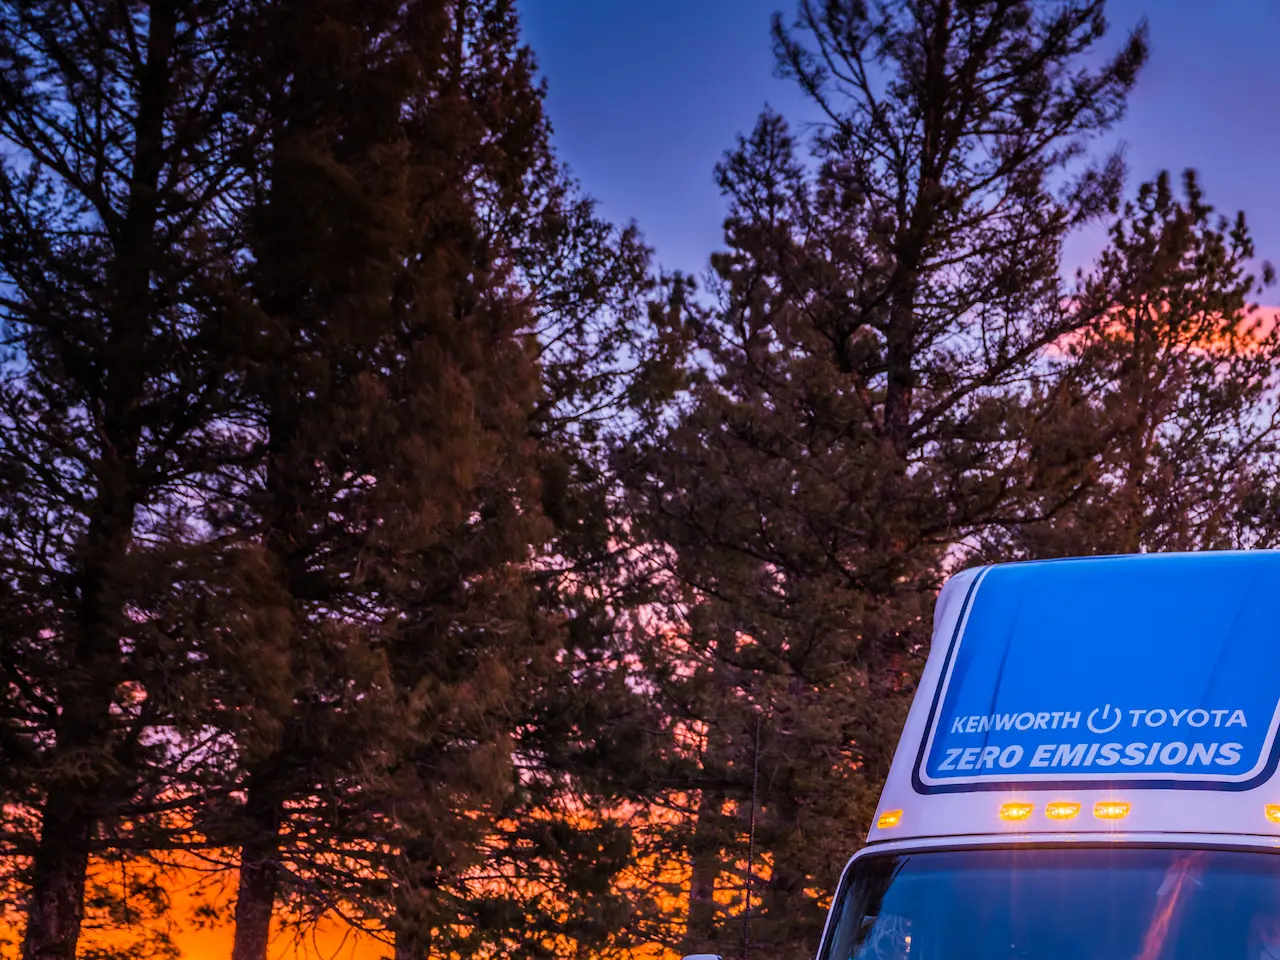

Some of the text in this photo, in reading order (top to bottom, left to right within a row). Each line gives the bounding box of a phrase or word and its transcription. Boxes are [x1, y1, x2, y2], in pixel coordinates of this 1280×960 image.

[951, 709, 1248, 734] KENWORTH TOYOTA
[937, 742, 1244, 771] ZERO EMISSIONS
